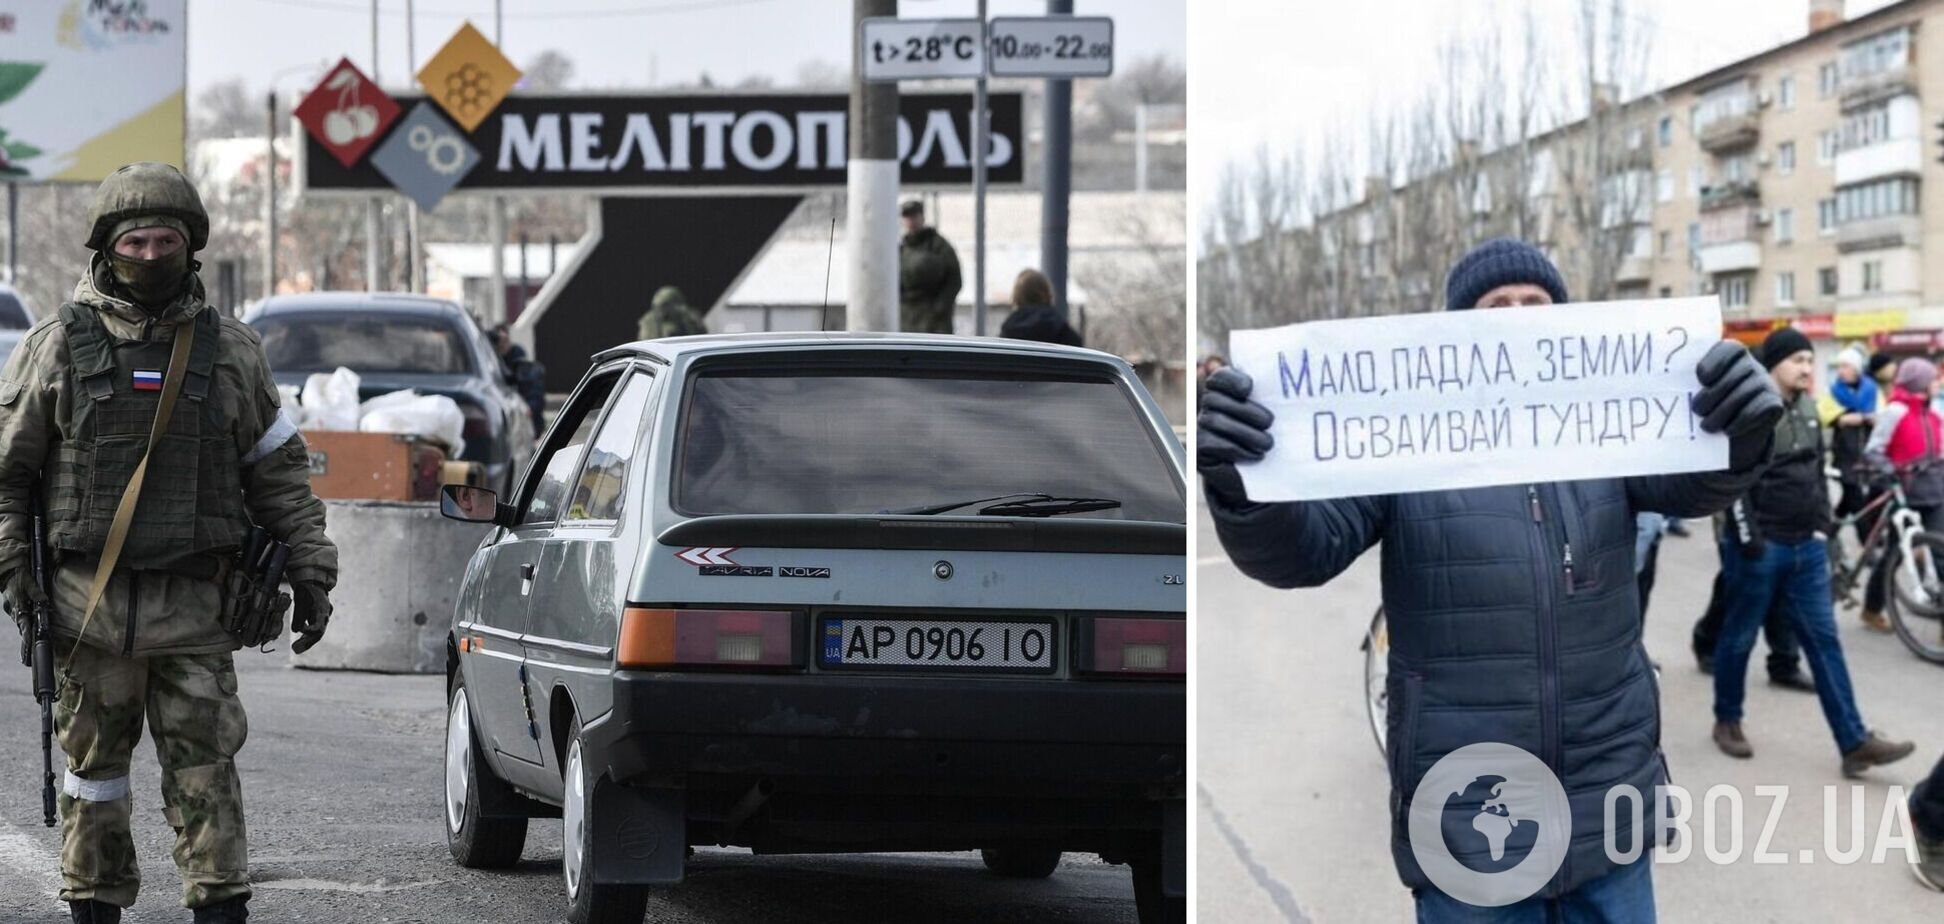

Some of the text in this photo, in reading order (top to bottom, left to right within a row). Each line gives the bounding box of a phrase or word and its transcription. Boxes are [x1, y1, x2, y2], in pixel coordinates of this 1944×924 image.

[497, 110, 1012, 171] МЕЛІТОПЛЬ
[780, 567, 829, 577] NOVA
[825, 648, 840, 658] UA
[906, 627, 985, 660] 0906
